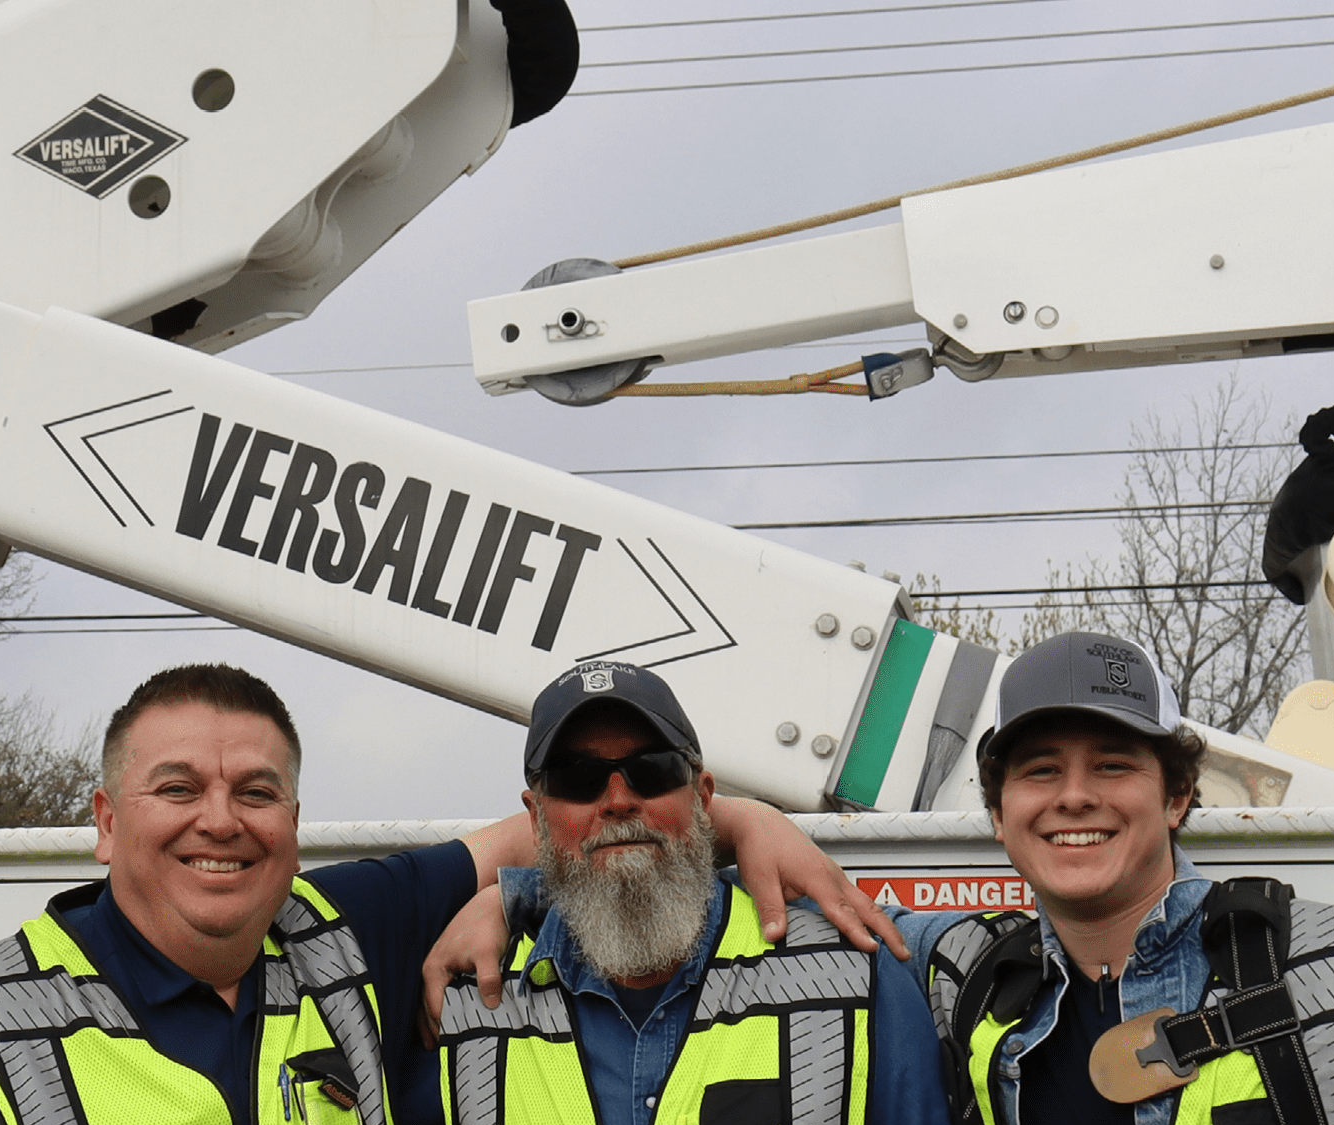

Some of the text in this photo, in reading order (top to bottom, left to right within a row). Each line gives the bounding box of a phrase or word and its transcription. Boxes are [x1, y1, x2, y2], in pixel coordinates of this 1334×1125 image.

[40, 134, 131, 162] VERSALIFT
[85, 164, 106, 172] TEXAS
[175, 412, 603, 652] VERSALIFT
[1094, 643, 1118, 653] CITY
[1091, 685, 1120, 695] PUBLIC
